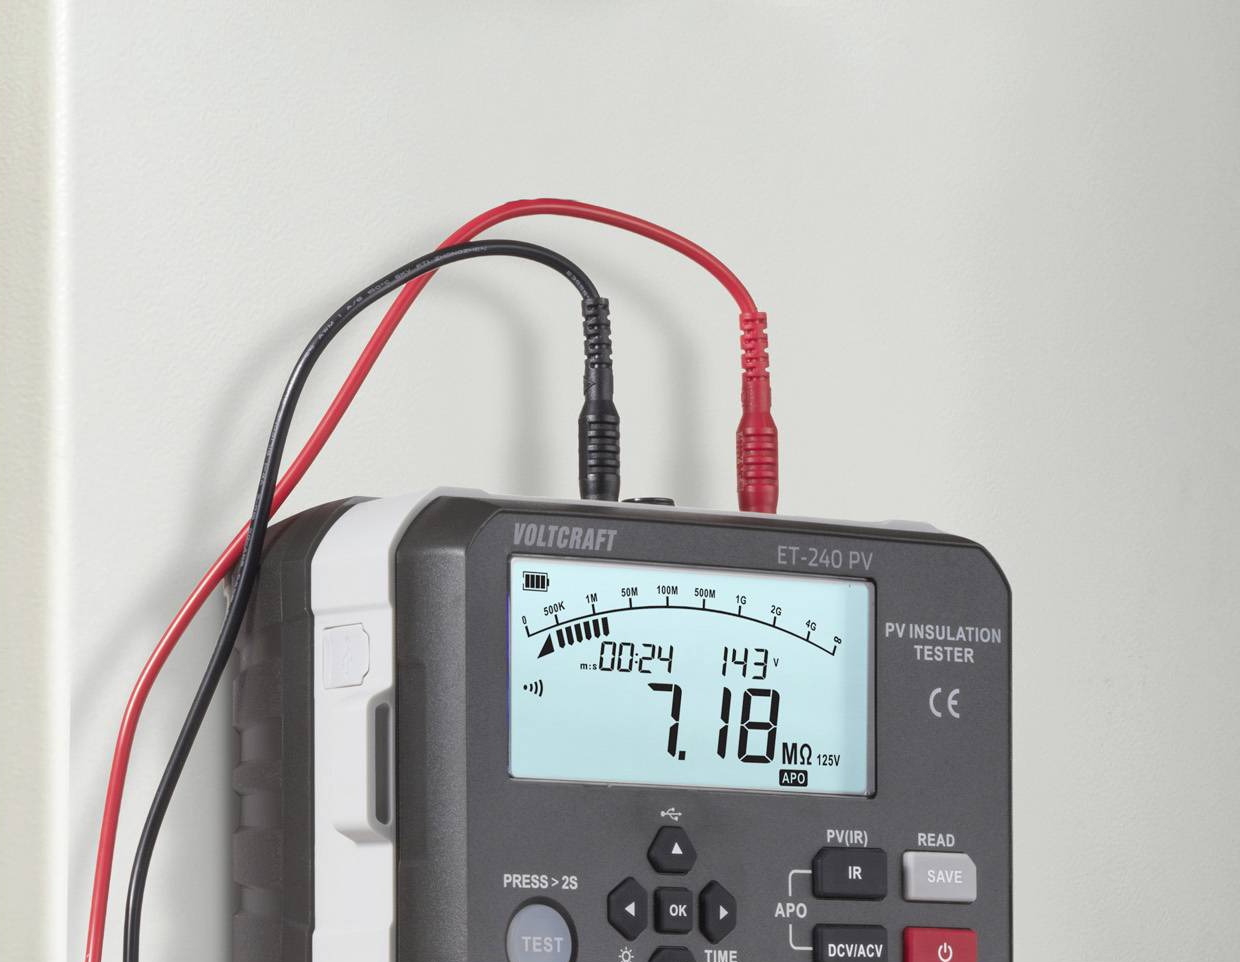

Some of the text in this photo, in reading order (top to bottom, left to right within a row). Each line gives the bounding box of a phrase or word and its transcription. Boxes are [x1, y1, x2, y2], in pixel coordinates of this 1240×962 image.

[513, 523, 617, 551] VOLTCRAFT
[777, 545, 873, 571] ET-240 PV
[521, 616, 528, 625] 0
[543, 601, 566, 616] 500K
[585, 593, 598, 604] 1M
[621, 587, 638, 598] 50M
[656, 585, 679, 595] 100M
[694, 587, 716, 599] 500M
[735, 595, 747, 605] 1G
[770, 605, 783, 617] 2G
[805, 619, 817, 632] 4G
[885, 622, 1001, 643] PV INSULATION
[580, 640, 674, 674] m:s 00:24
[914, 645, 975, 663] TESTER
[722, 646, 780, 680] 143 V
[647, 682, 781, 764] 7.18
[817, 754, 841, 767] 125V
[781, 772, 806, 785] APO
[827, 829, 868, 847] PV(IR)
[918, 833, 955, 847] READ
[503, 873, 549, 889] PRESS
[561, 875, 578, 890] 2S
[848, 866, 862, 880] IR
[927, 870, 963, 884] SAVE
[669, 904, 688, 917] OK
[774, 902, 807, 919] APO
[521, 936, 564, 953] TEST
[828, 944, 883, 959] DCV/ACV
